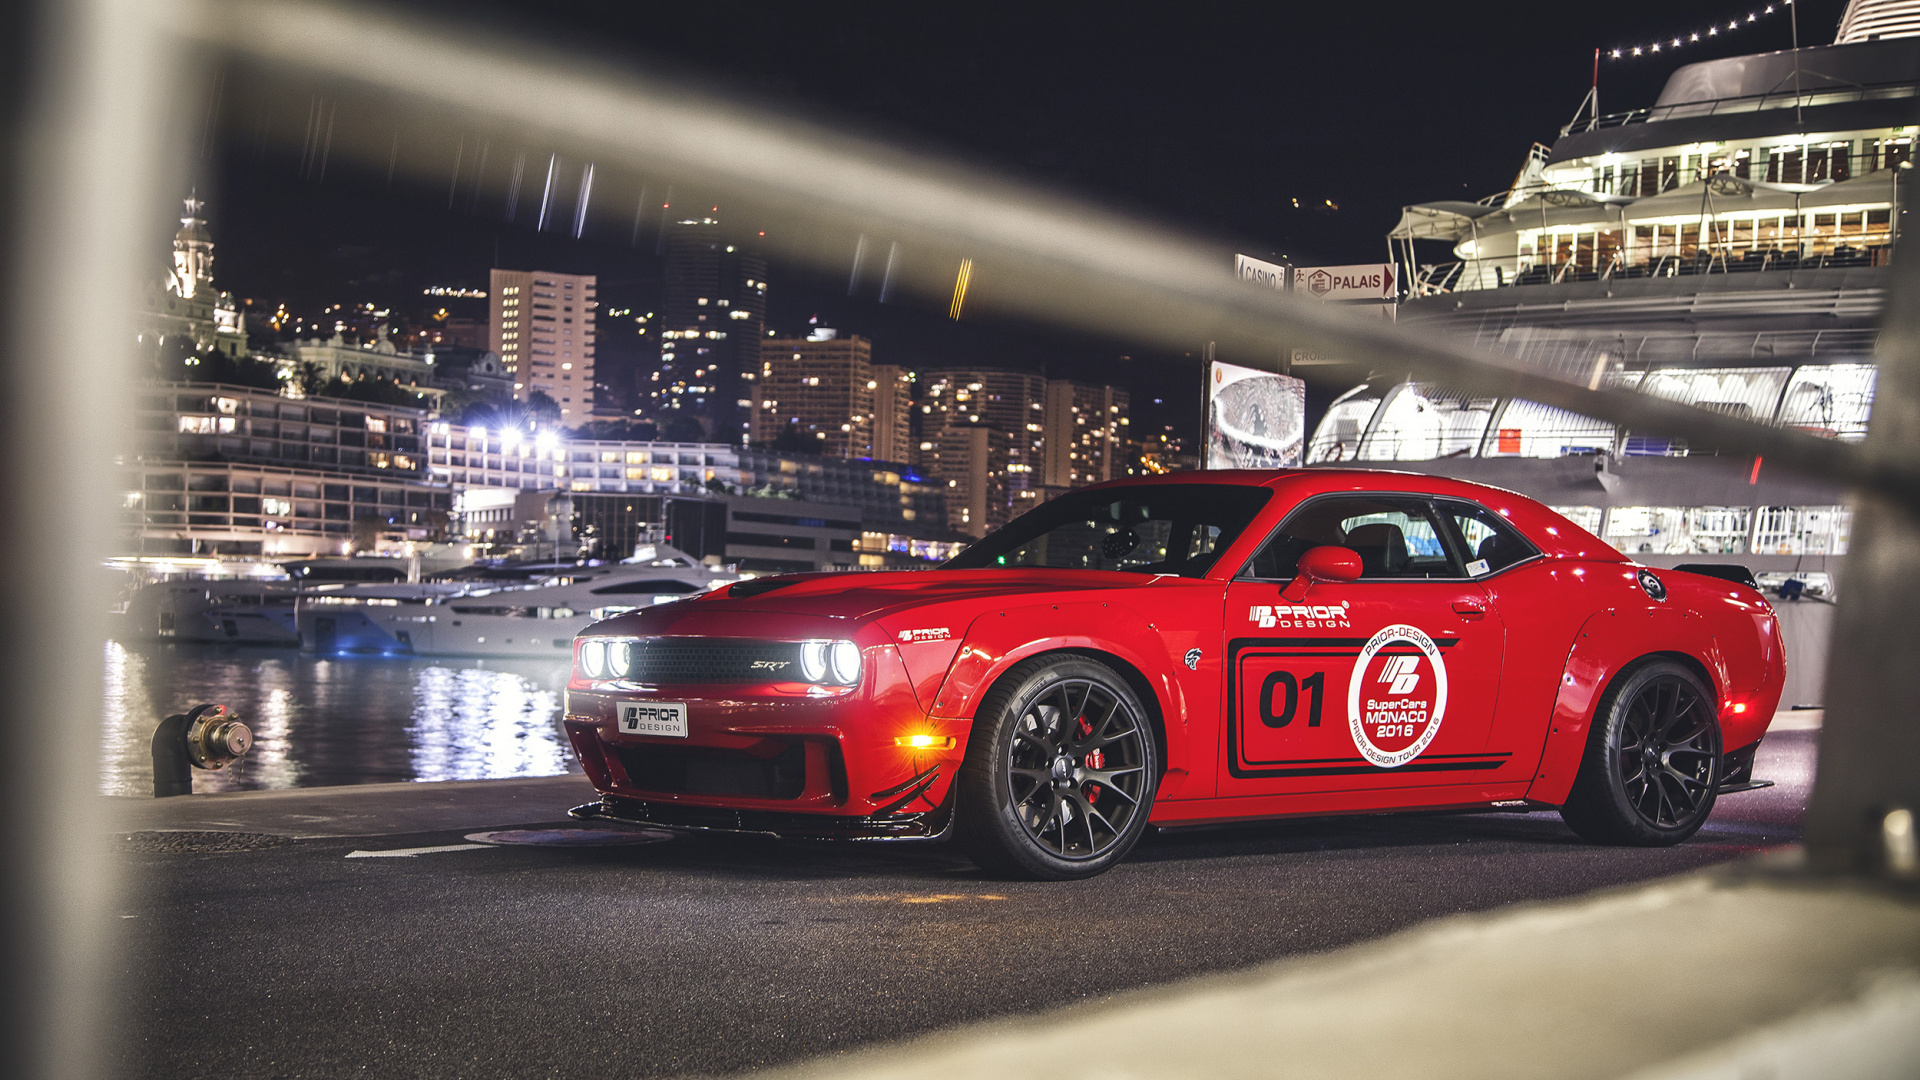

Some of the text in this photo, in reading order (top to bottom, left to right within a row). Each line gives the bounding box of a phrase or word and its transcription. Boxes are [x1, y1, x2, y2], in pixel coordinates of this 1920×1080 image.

[1245, 266, 1277, 289] CASINO
[1333, 274, 1381, 290] PALAIS
[1280, 620, 1351, 628] DESIGN
[912, 627, 950, 637] PRIOR
[913, 633, 952, 641] DESIGN
[1365, 627, 1436, 656] PRIOR-DESIGN
[750, 660, 791, 671] SRT
[1259, 670, 1325, 729] 01
[1366, 698, 1428, 712] SuperCars
[638, 707, 680, 722] PRIOR
[1365, 710, 1428, 724] MONACO
[639, 722, 681, 732] DESIGN
[1376, 724, 1415, 738] 2016
[1352, 717, 1440, 764] PRIOR-DESIGN TOUR 2016
